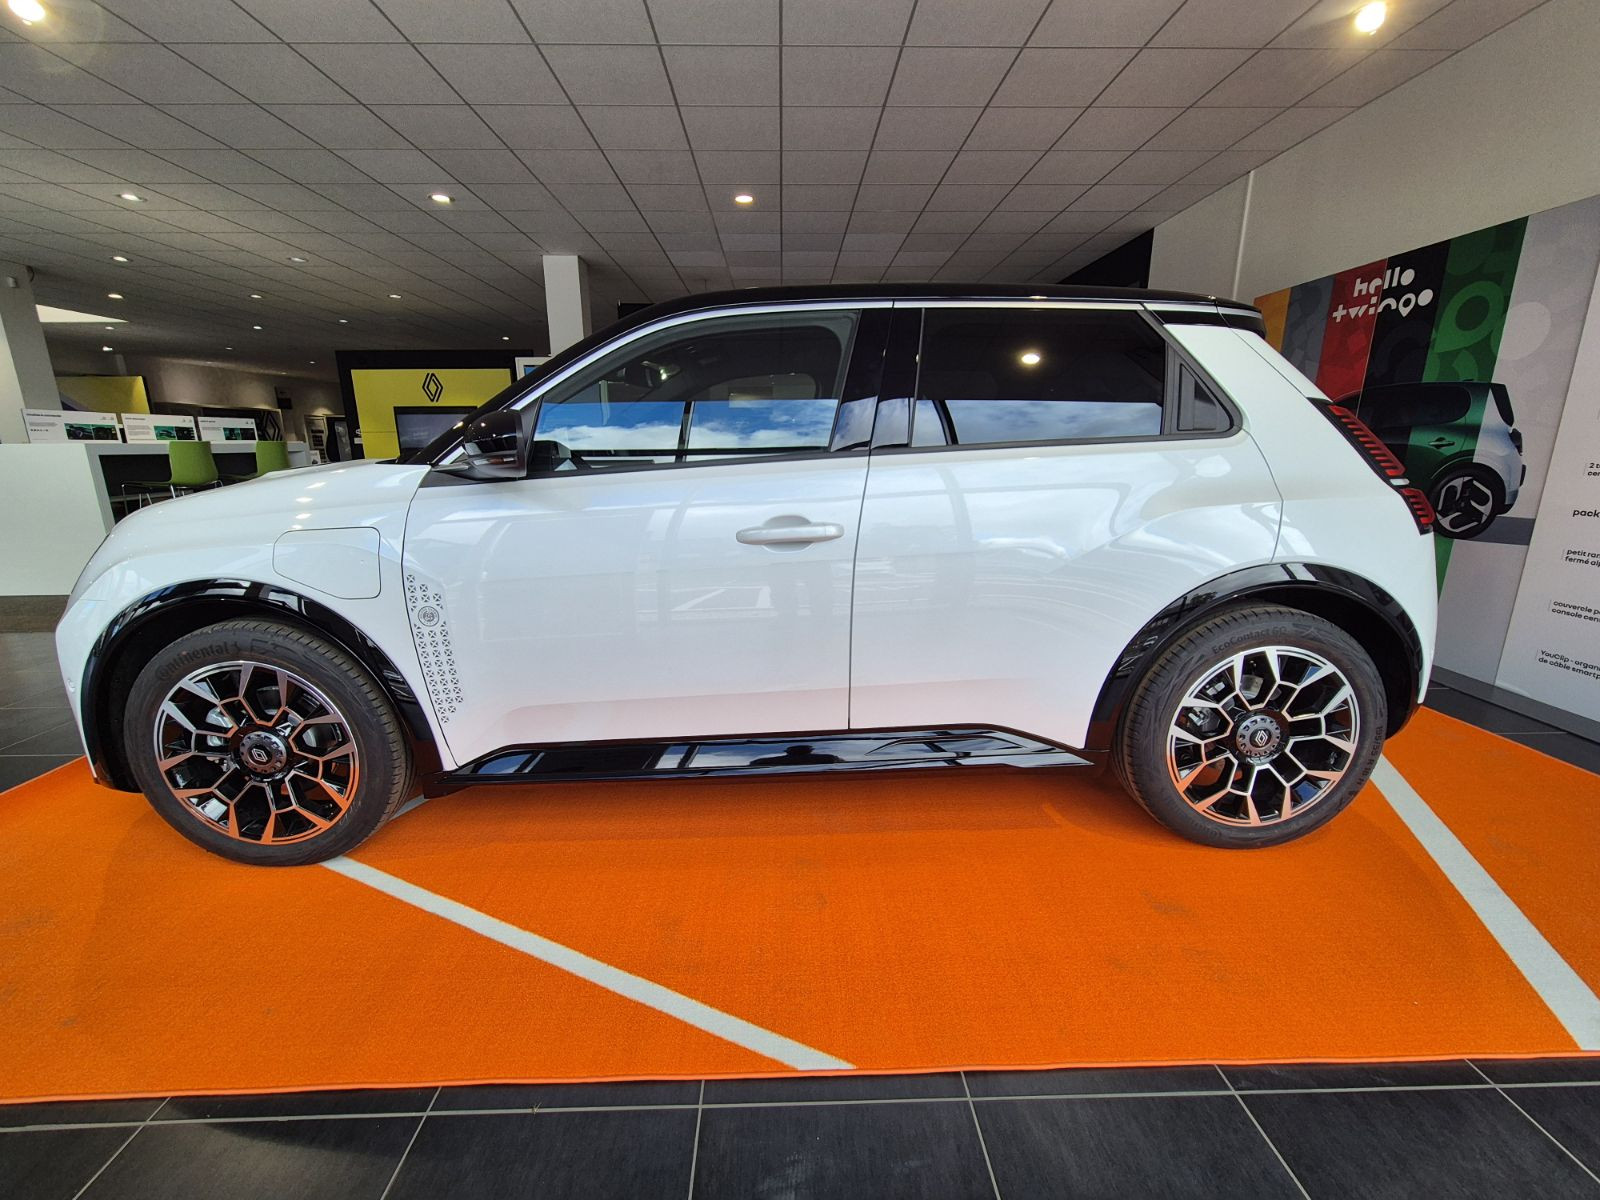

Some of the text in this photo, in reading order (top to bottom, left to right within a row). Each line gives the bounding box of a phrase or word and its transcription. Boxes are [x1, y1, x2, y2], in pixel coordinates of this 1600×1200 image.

[1353, 266, 1415, 297] hello
[1332, 288, 1434, 323] twingo
[1572, 509, 1600, 518] pack
[1566, 549, 1586, 557] petit
[1564, 555, 1590, 565] fermé
[1553, 601, 1592, 612] couvercle
[1551, 608, 1582, 618] console
[1541, 650, 1569, 662] YouClip
